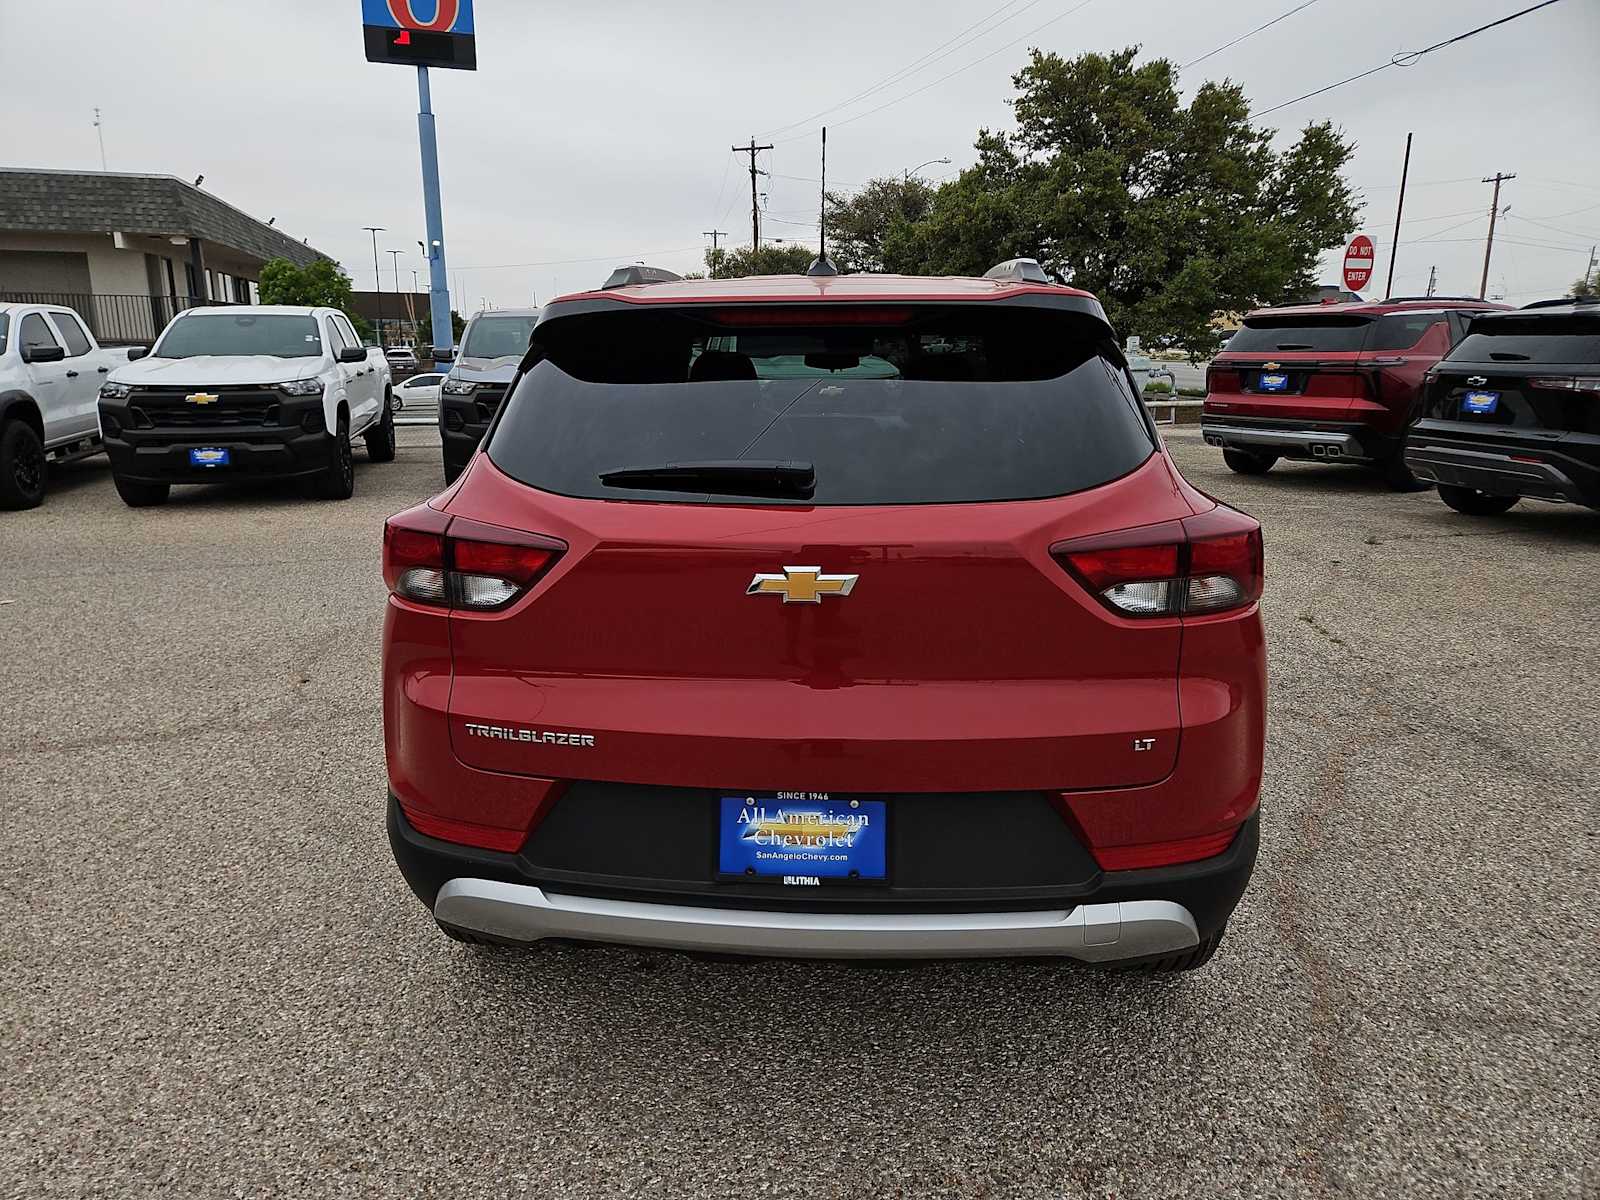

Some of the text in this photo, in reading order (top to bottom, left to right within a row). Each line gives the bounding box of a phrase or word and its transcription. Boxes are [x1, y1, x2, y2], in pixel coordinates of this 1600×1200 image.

[1349, 246, 1372, 256] DO NOT
[1347, 271, 1367, 281] ENTER
[465, 723, 595, 747] TRAILBLAZER
[1134, 738, 1156, 751] LT
[777, 791, 829, 801] SINCE 1946
[737, 807, 870, 826] All American
[754, 829, 854, 848] Chevrolet
[756, 850, 848, 862] SanAngeloChevy.com
[791, 876, 820, 886] LITHIA
